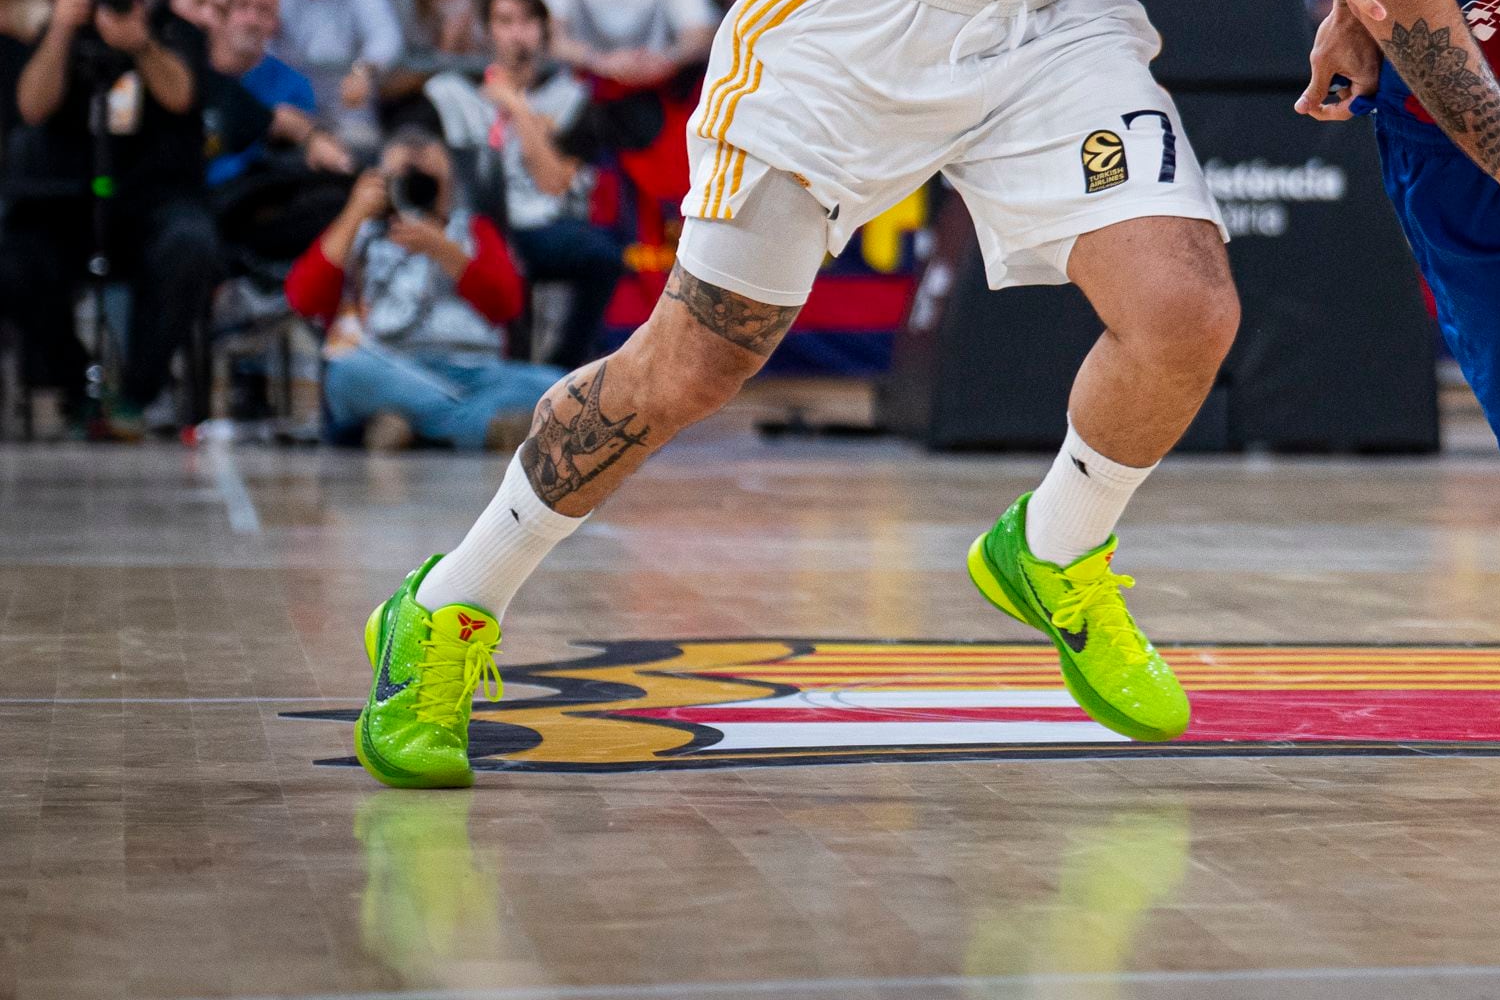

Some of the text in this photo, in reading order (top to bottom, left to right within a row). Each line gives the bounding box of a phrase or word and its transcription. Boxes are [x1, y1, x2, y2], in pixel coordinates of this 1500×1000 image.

[1120, 109, 1176, 183] 7
[1089, 166, 1124, 182] TURKISH
[1089, 173, 1125, 188] AIRLINES
